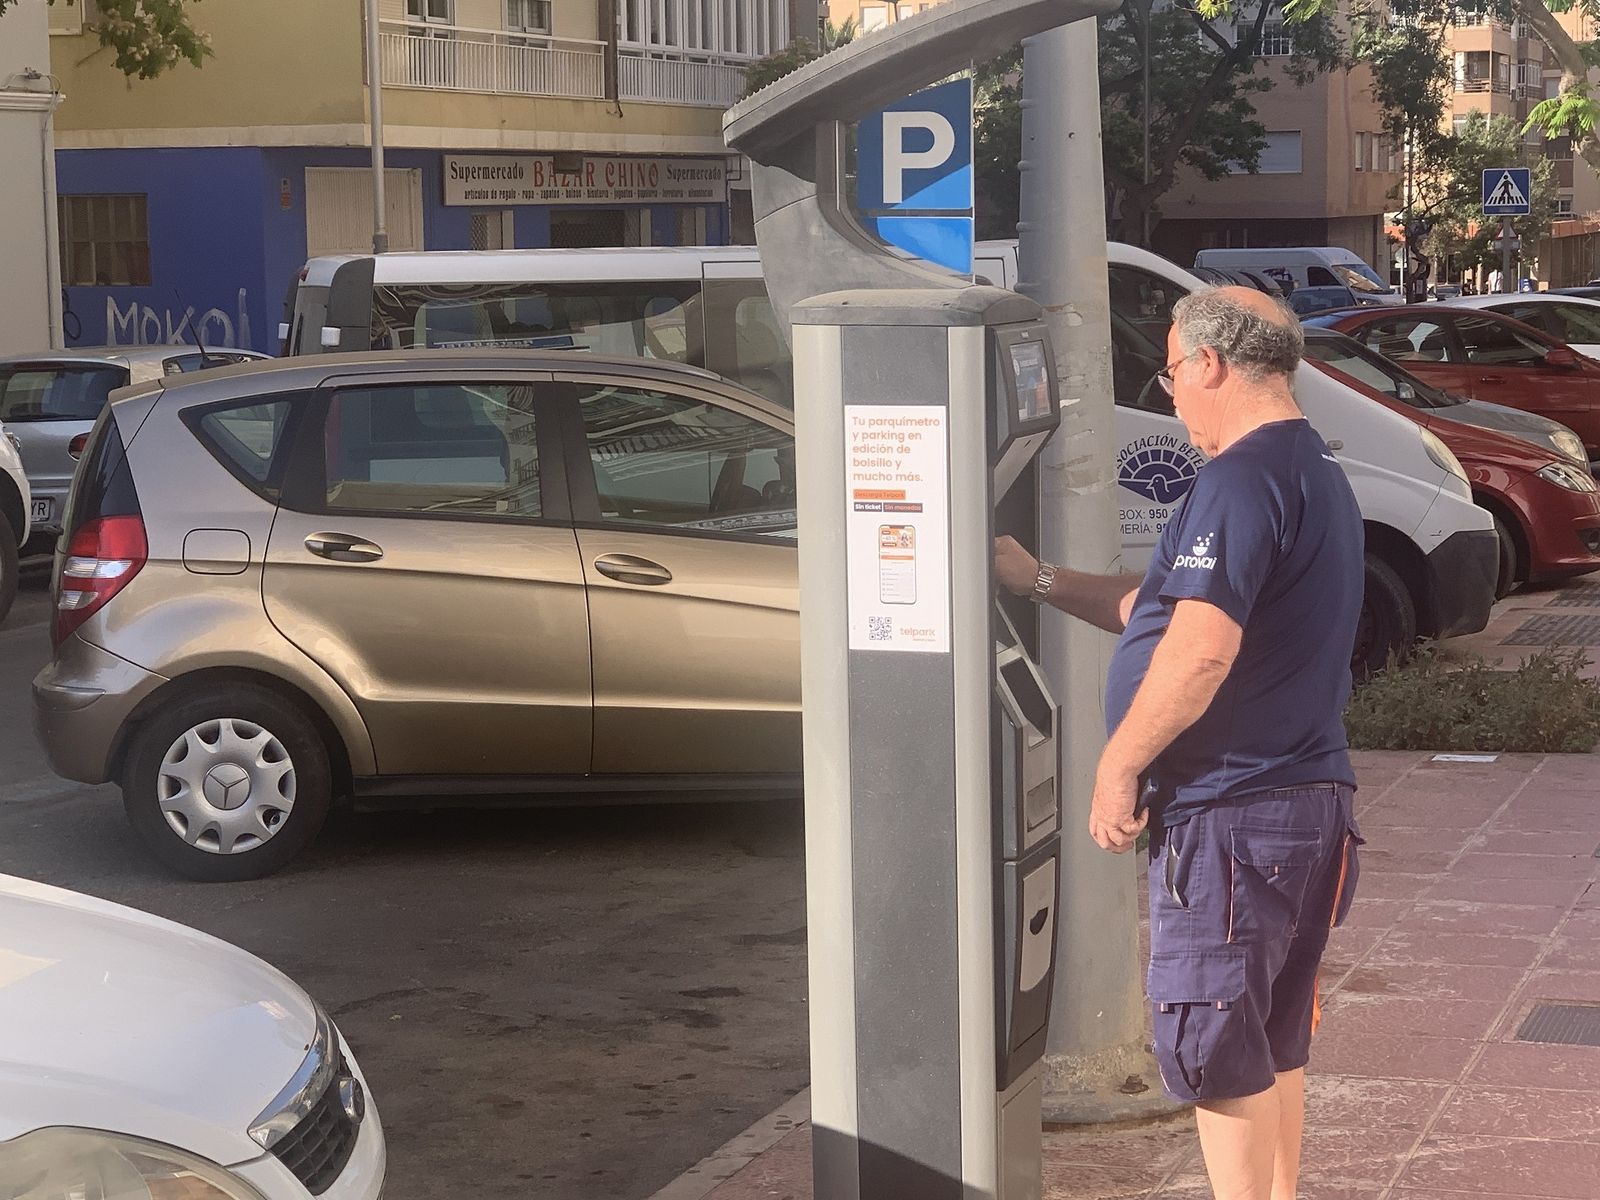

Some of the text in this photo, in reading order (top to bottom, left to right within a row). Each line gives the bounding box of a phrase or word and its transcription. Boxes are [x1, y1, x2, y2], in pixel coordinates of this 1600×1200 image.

[883, 111, 955, 204] P
[450, 161, 524, 182] Supermercado
[605, 162, 658, 187] CHINO
[667, 164, 721, 182] Supermercado
[852, 416, 940, 428] Tu parquímetro
[852, 432, 859, 441] y
[862, 431, 905, 442] parking
[852, 444, 911, 453] edición de
[1116, 433, 1178, 470] SOCIACIÓN
[852, 458, 902, 470] bolsillo y
[853, 472, 924, 481] mucho más.
[1149, 509, 1168, 519] 950
[900, 627, 935, 637] telpark
